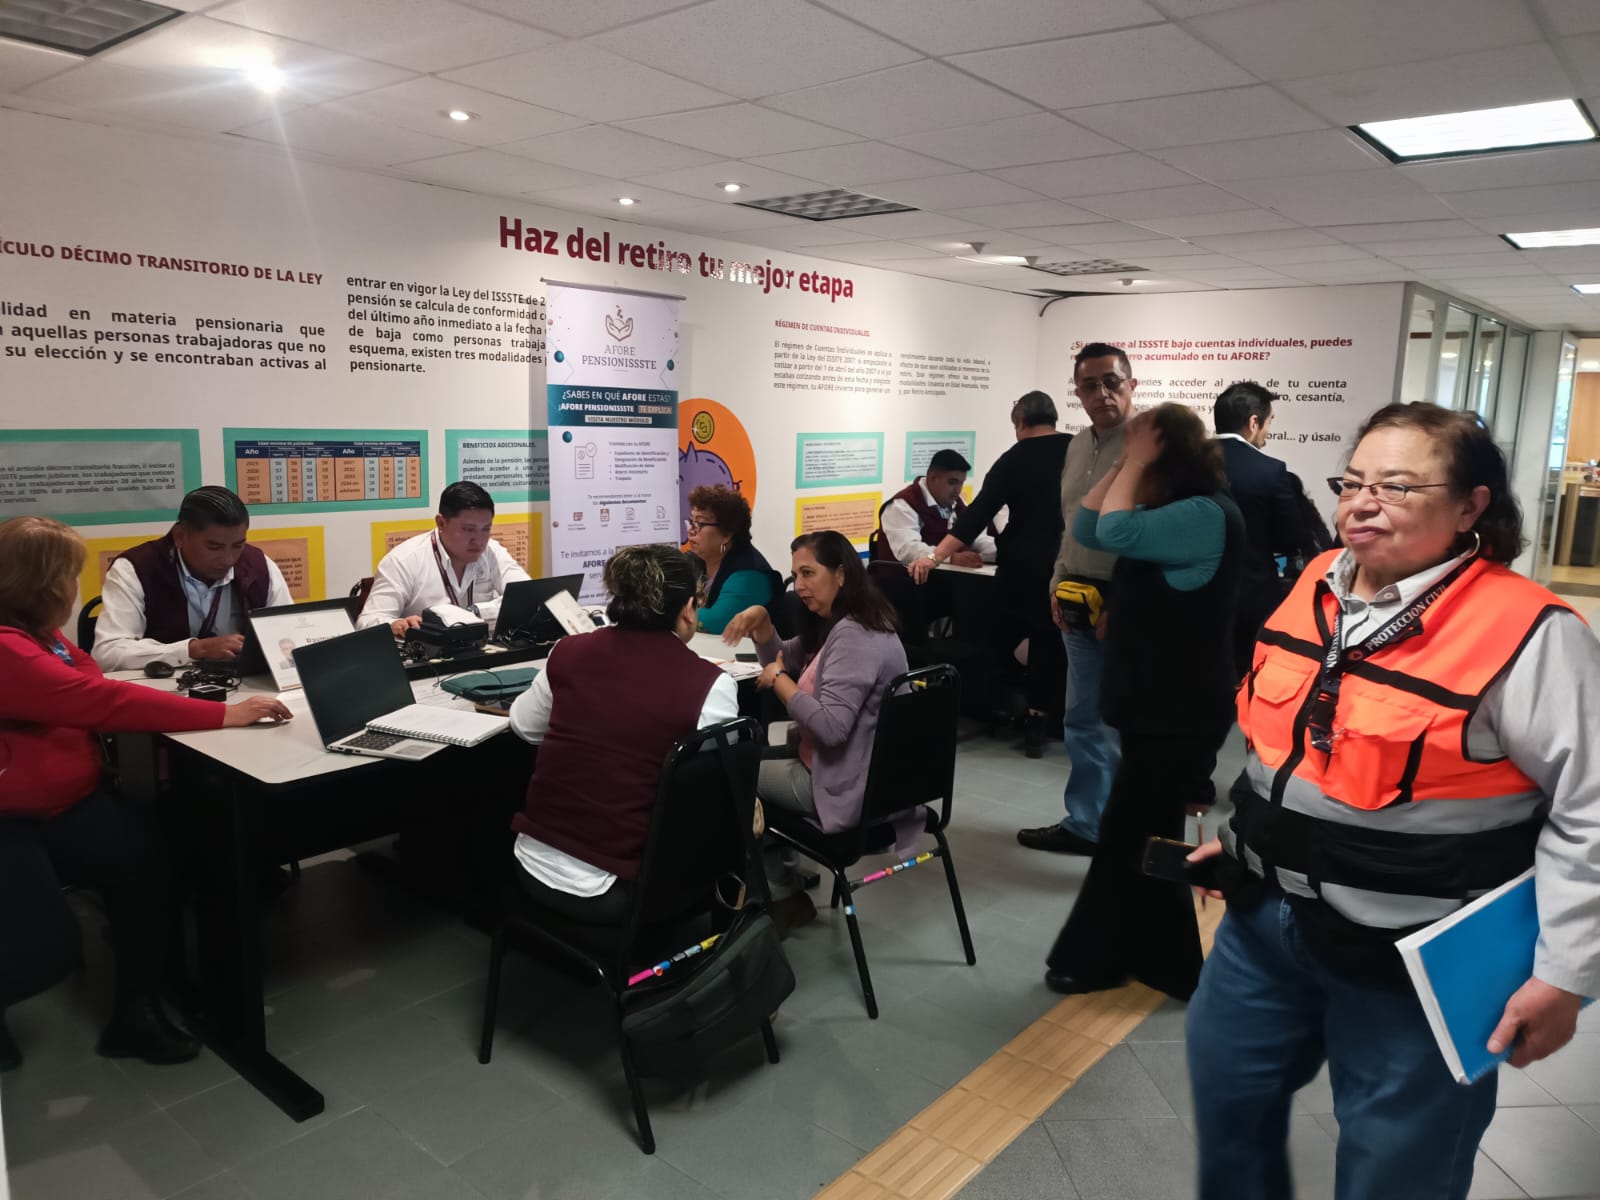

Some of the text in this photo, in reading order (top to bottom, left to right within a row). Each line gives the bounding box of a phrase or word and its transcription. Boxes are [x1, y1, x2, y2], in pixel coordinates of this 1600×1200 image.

[61, 244, 132, 265] DÉCIMO
[137, 254, 249, 277] TRANSITORIO
[254, 267, 272, 280] DE
[277, 269, 295, 282] LA
[299, 271, 323, 285] LEY
[500, 216, 854, 303] Haz del retiro tu mejor etapa
[346, 276, 386, 289] entrar
[390, 281, 404, 291] en
[407, 282, 437, 296] vigor
[440, 285, 449, 296] la
[452, 286, 471, 301] Ley
[473, 289, 489, 300] del
[492, 291, 524, 304] ISSSTE
[526, 296, 538, 306] de
[348, 294, 537, 320] pensión se calcula de conformidad
[1, 301, 325, 338] lidad en materia pensionaria que
[348, 308, 542, 334] del último año inmediato a la fecha
[11, 325, 326, 354] aquellas personas trabajadoras que no
[348, 324, 546, 352] de baja como personas trabaja
[1128, 340, 1136, 348] al
[1139, 340, 1168, 348] ISSSTE
[1171, 340, 1192, 350] bajo
[1194, 339, 1236, 348] cuentas
[1238, 338, 1308, 348] individuales,
[1310, 337, 1352, 349] puedes
[5, 344, 327, 370] su elección y se encontraban activas al
[349, 344, 542, 364] esquema, existen tres modalidades
[604, 345, 636, 356] AFORE
[1144, 352, 1200, 361] acumulado
[1217, 352, 1228, 361] tu
[1230, 352, 1270, 360] AFORE?
[350, 360, 426, 373] pensionarte.
[582, 355, 657, 370] PENSIONISSSTE
[1137, 377, 1347, 388] uedes acceder al de tu cuenta
[562, 390, 590, 400] ¿SABES
[592, 391, 602, 400] EN
[604, 390, 620, 401] QUÉ
[622, 393, 647, 402] AFORE
[1168, 390, 1219, 400] subcuenta
[1296, 392, 1344, 403] cesantía,
[584, 404, 634, 412] PENSIONISSSTE
[1312, 432, 1342, 442] úsalo
[560, 551, 570, 559] Te
[570, 548, 602, 558] invitamos
[1365, 602, 1426, 651] PROTECCION
